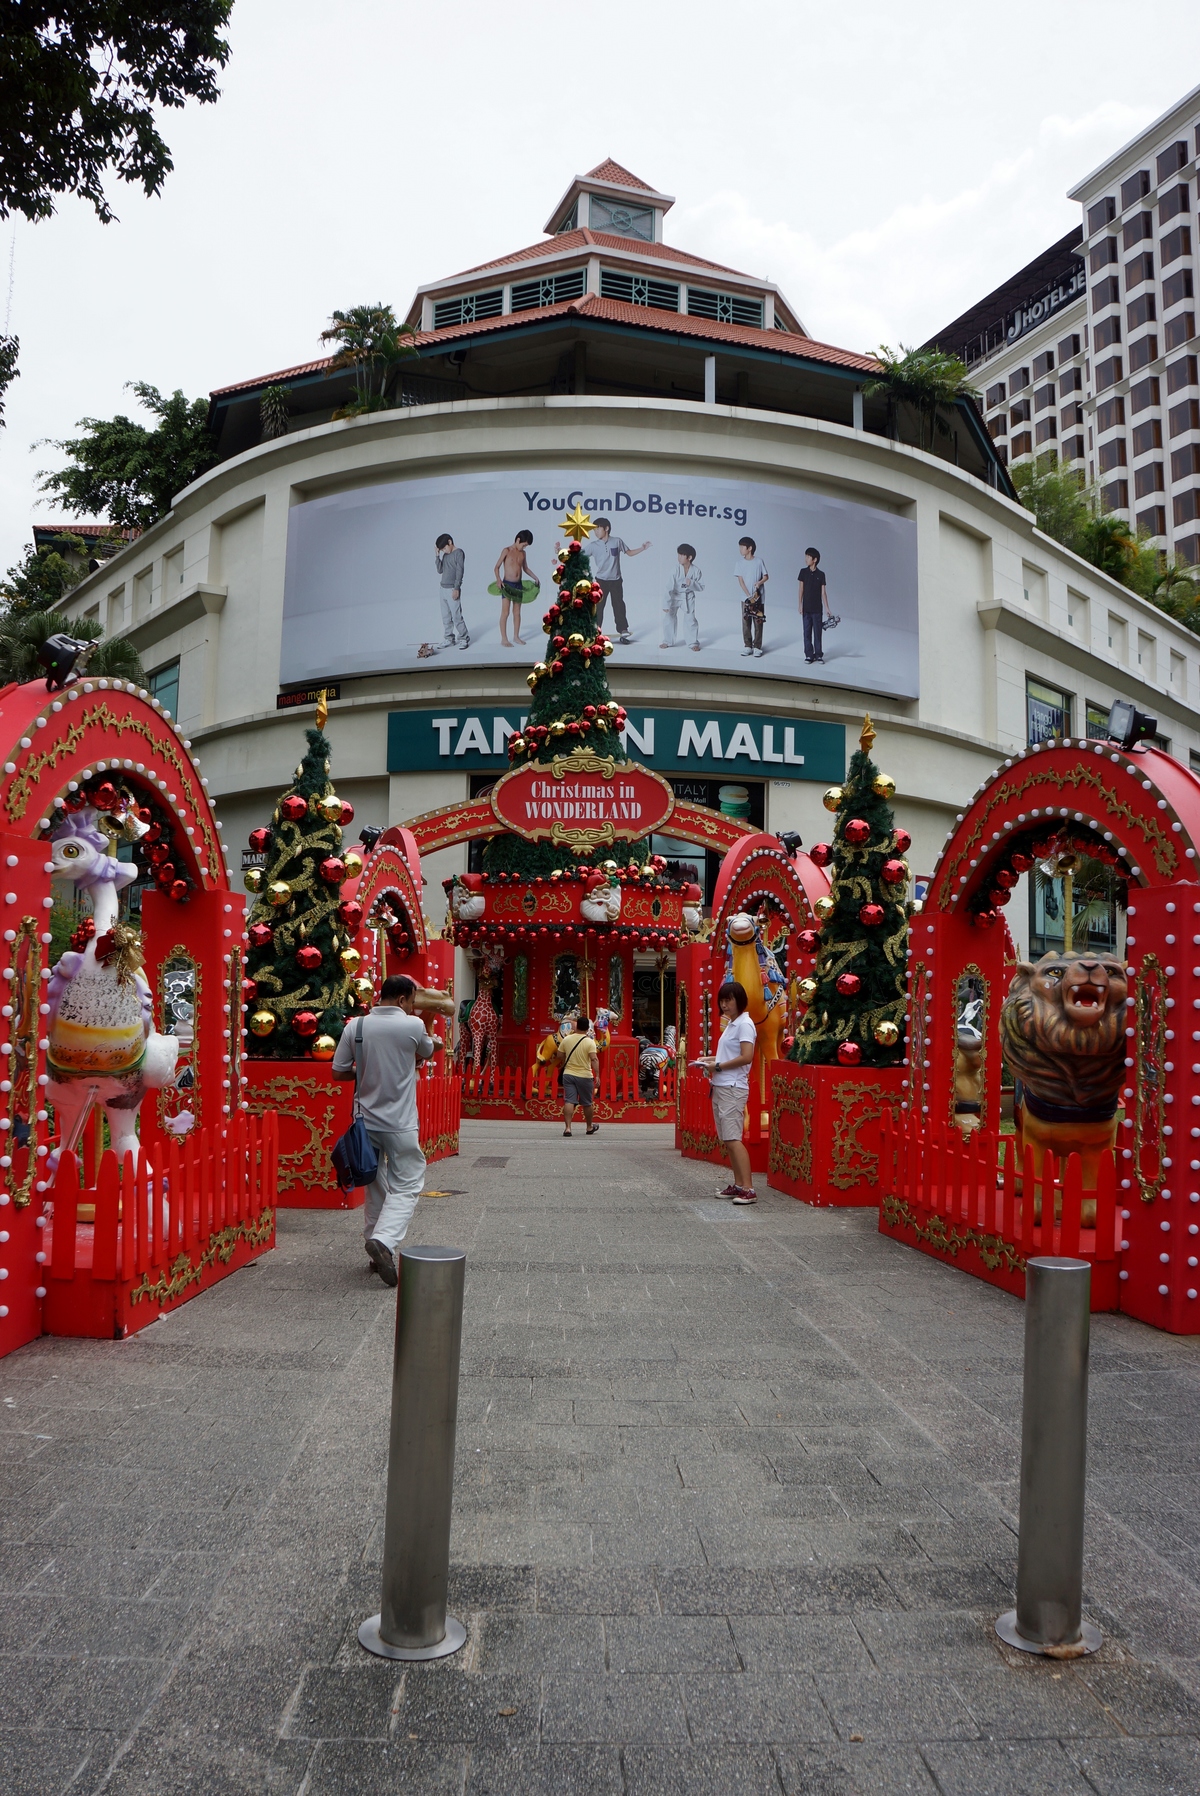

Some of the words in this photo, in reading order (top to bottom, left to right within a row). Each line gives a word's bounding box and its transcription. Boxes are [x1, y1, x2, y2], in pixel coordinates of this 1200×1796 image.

[1023, 286, 1068, 327] HOTEL
[523, 491, 748, 526] YouCanDoBetter.sg
[1034, 708, 1052, 725] tango
[432, 717, 655, 756] TANN
[677, 719, 804, 765] MALL
[531, 781, 615, 799] Christmas
[619, 781, 635, 799] in
[673, 784, 706, 795] ITALY
[525, 801, 642, 820] WONDERLAND
